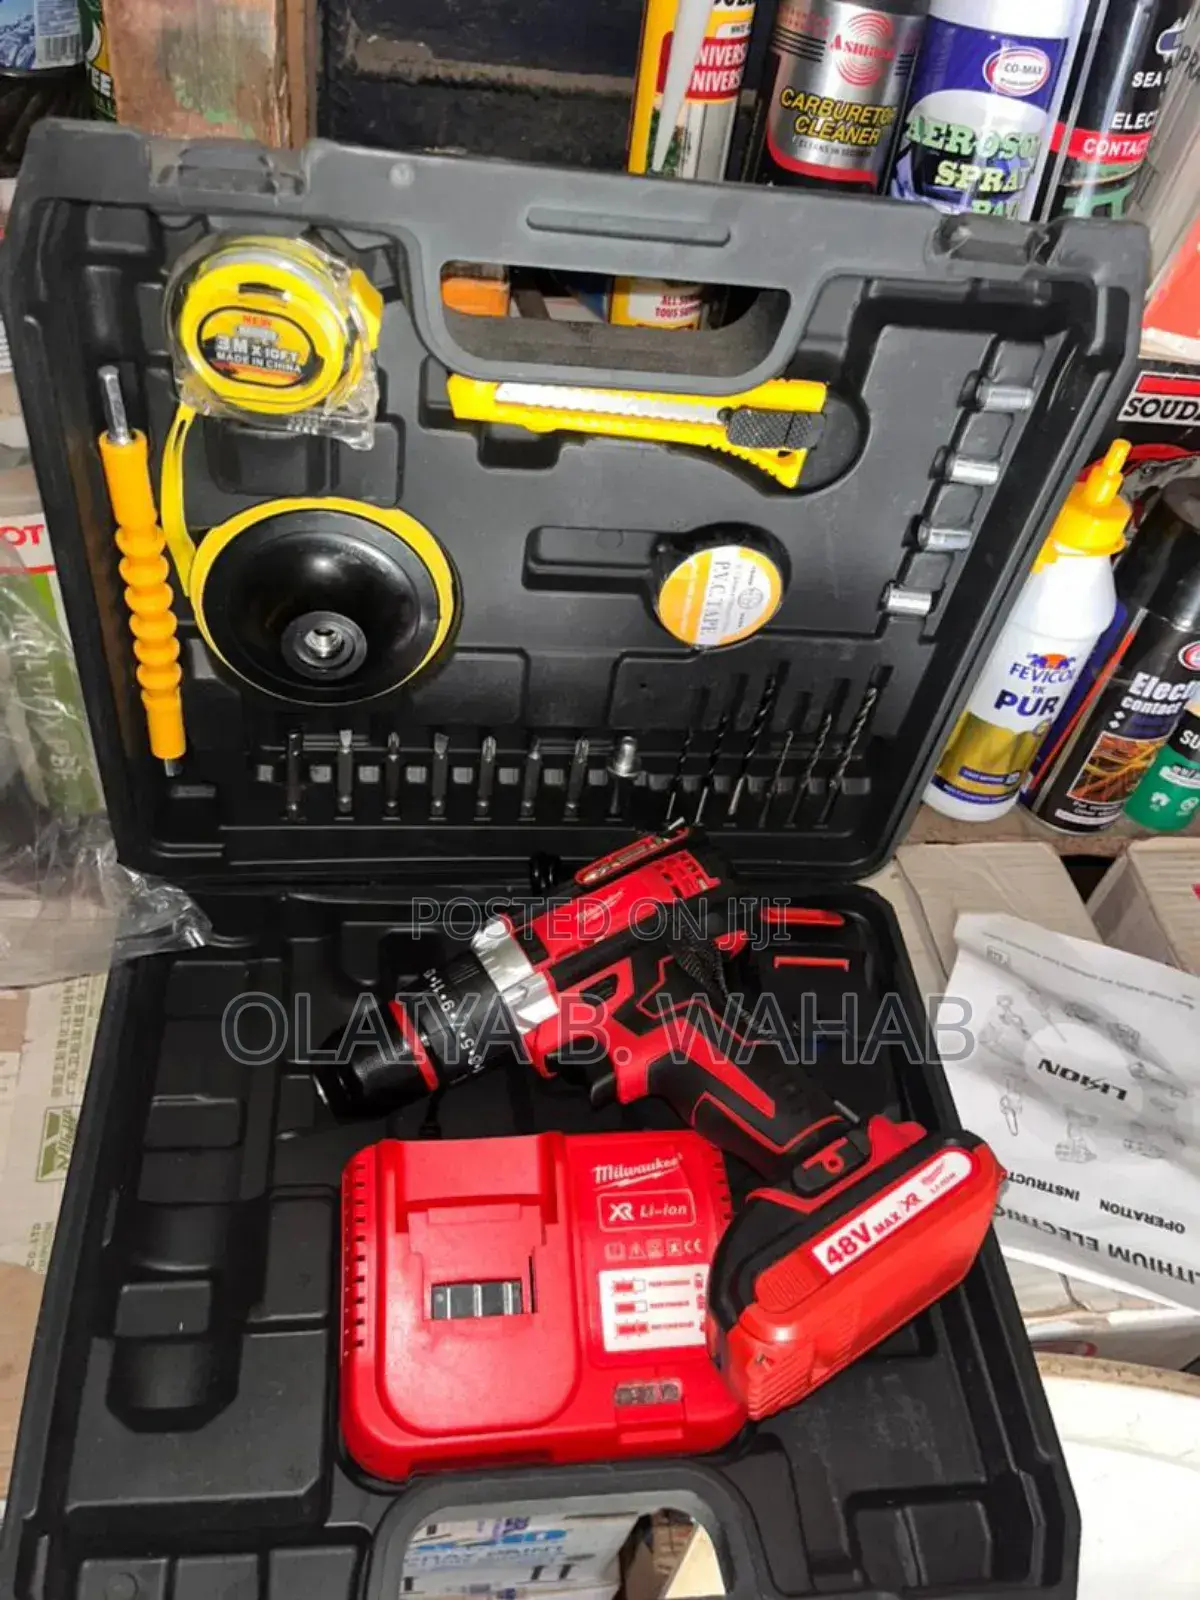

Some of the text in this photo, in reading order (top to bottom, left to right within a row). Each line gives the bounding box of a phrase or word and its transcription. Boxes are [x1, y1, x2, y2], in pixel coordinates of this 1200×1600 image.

[794, 114, 882, 147] CLEANER
[1123, 397, 1200, 420] SOUD
[994, 689, 1060, 716] PUR
[592, 1156, 680, 1185] Milwaukee
[1100, 1198, 1186, 1234] OPERATION
[826, 1222, 872, 1266] 48V
[872, 1211, 902, 1235] MAX
